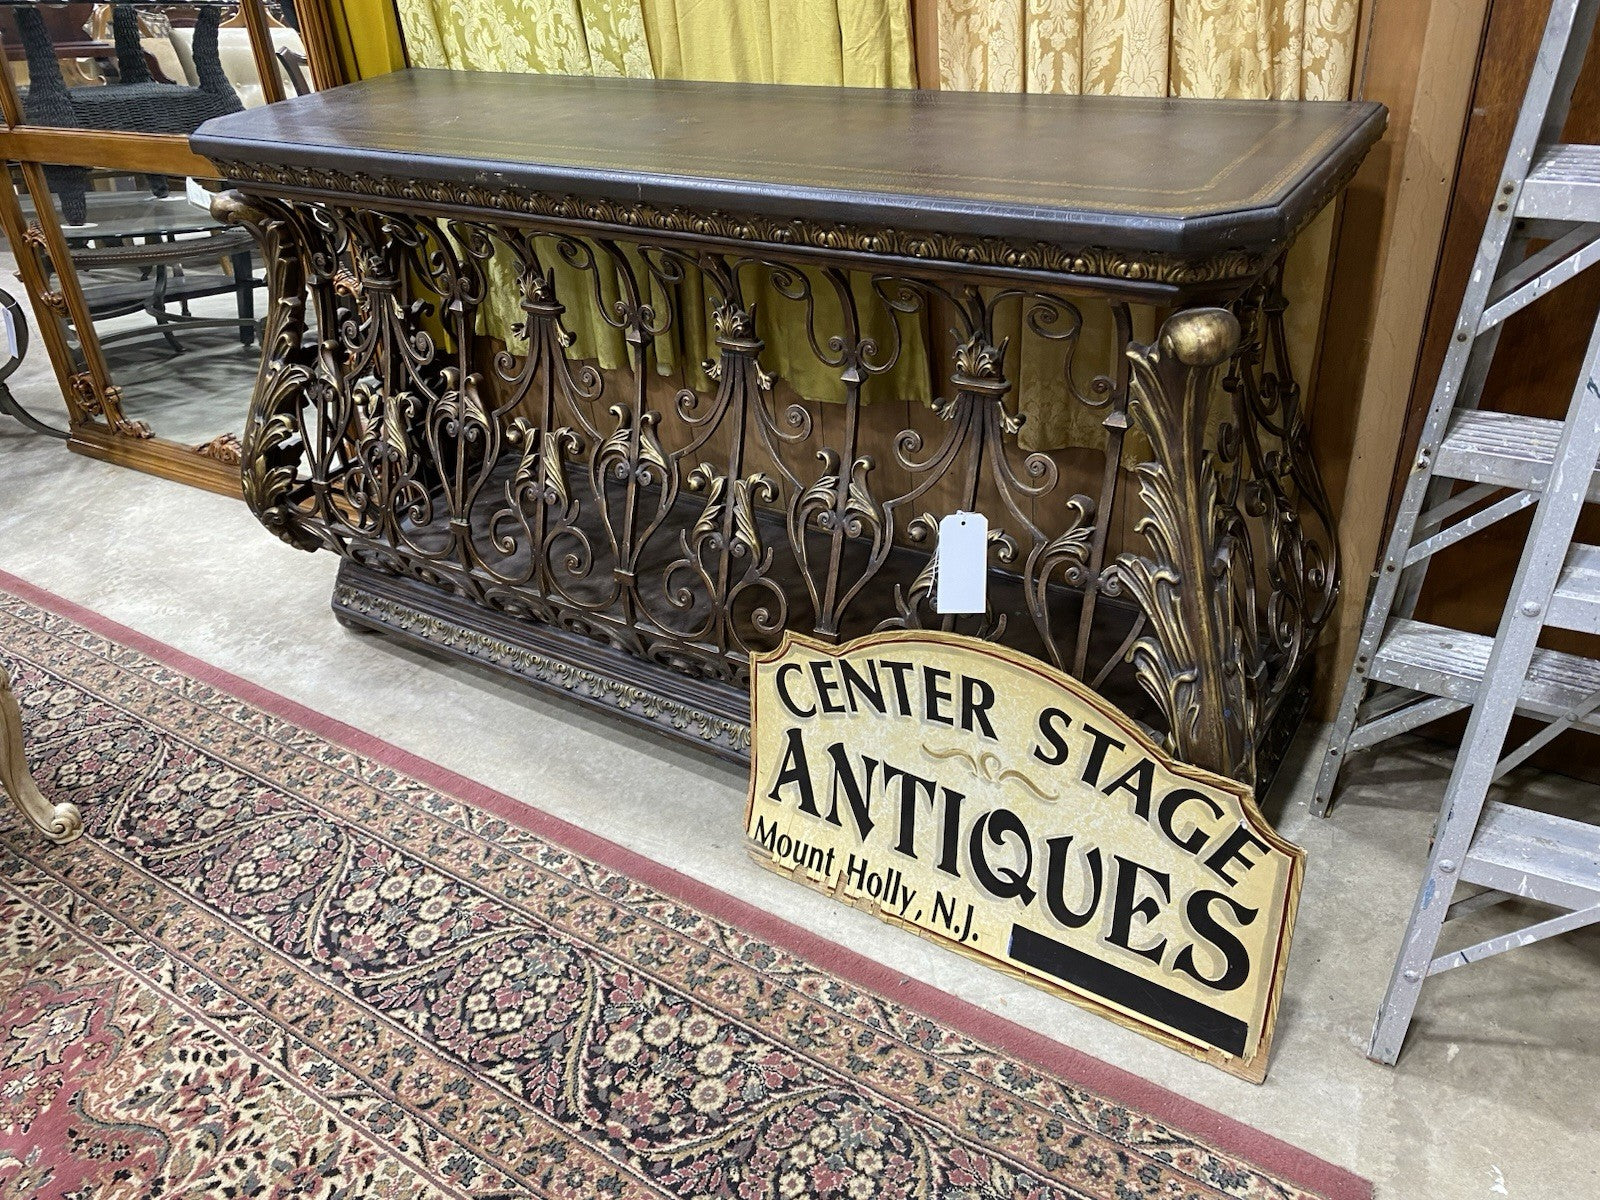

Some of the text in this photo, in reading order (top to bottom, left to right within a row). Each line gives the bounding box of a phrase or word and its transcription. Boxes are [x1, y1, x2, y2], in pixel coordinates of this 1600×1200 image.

[754, 815, 979, 942] Mount Holly, N.J.
[768, 727, 1259, 991] ANTIQUES
[775, 659, 1272, 888] CENTER STAGE
